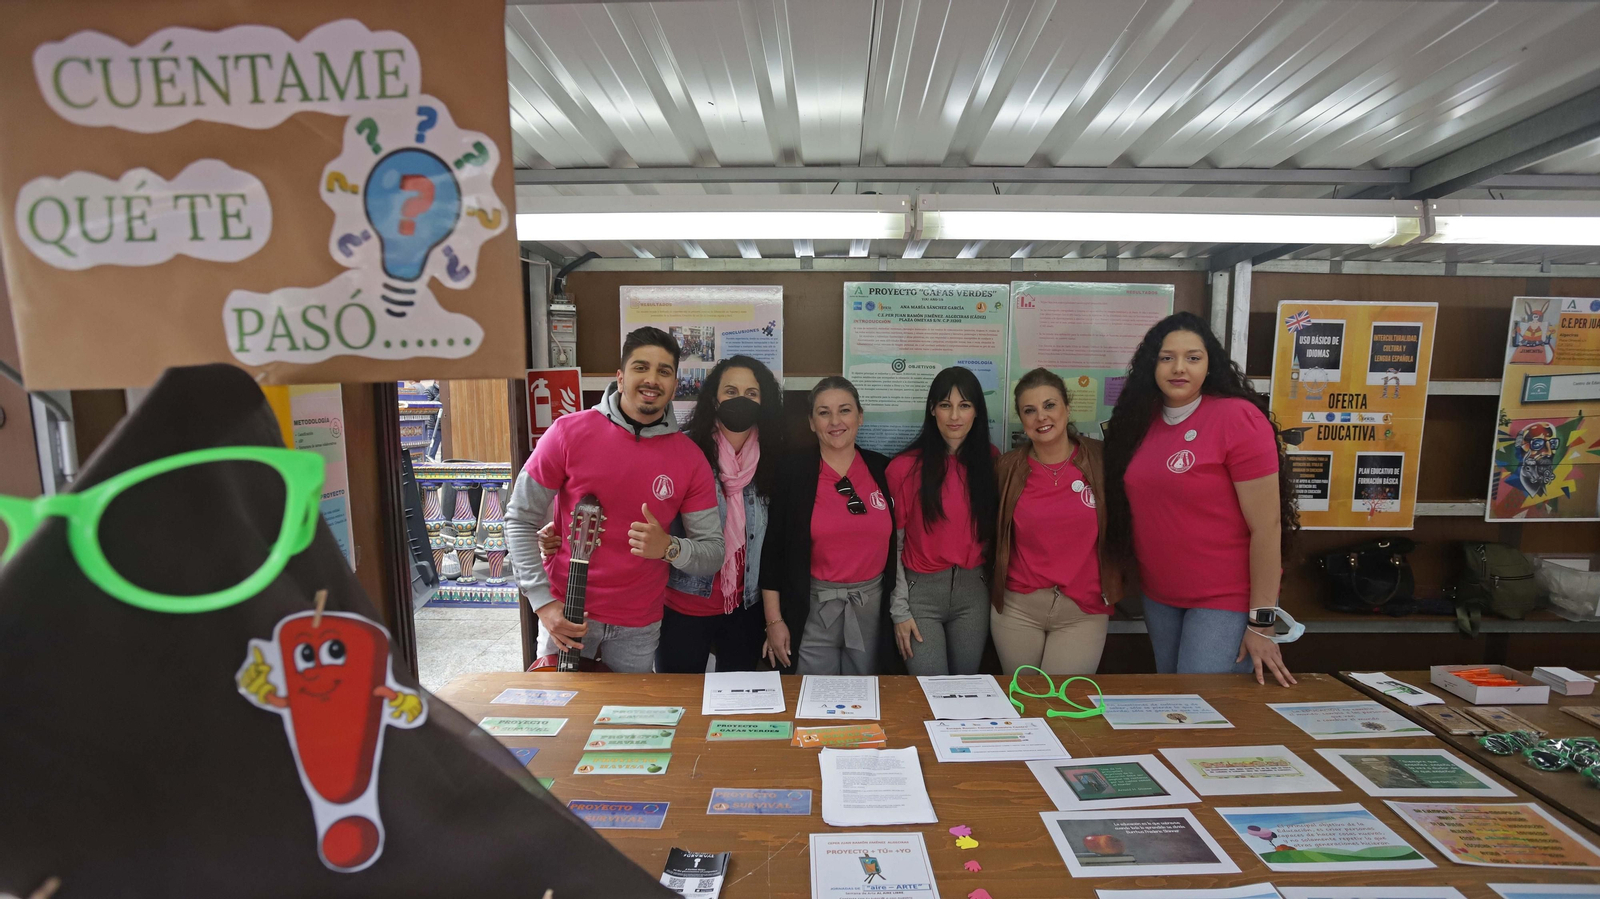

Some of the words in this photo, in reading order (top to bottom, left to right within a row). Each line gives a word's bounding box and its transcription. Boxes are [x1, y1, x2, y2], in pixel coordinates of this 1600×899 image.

[52, 41, 409, 109] CUÉNTAME
[28, 180, 158, 257] QUÉ
[173, 193, 253, 242] TE
[869, 287, 918, 297] PROYECTO
[1561, 317, 1588, 330] C.E.PER
[1588, 318, 1600, 330] JUA
[722, 328, 759, 337] CONCLUSIONES
[1299, 335, 1310, 345] USO
[1311, 334, 1330, 345] BÁSICO
[1330, 336, 1340, 346] DE
[1305, 348, 1330, 359] IDIOMAS
[1373, 354, 1391, 363] LENGUA
[1391, 353, 1413, 363] ESPAÑOLA
[1327, 393, 1367, 410] OFERTA
[293, 417, 330, 426] METODOLOGÍA
[1317, 425, 1376, 441] EDUCATIVA
[1358, 467, 1370, 475] PLAN
[1370, 467, 1392, 476] EDUCATIVO
[1393, 468, 1399, 476] DE
[1357, 476, 1382, 486] FORMACIÓN
[1383, 477, 1399, 486] BÁSICA
[716, 791, 778, 799] PROYECTO
[570, 803, 633, 812] PROYECTO
[732, 802, 792, 810] SURVIVAL
[584, 814, 646, 823] SURVIVAL
